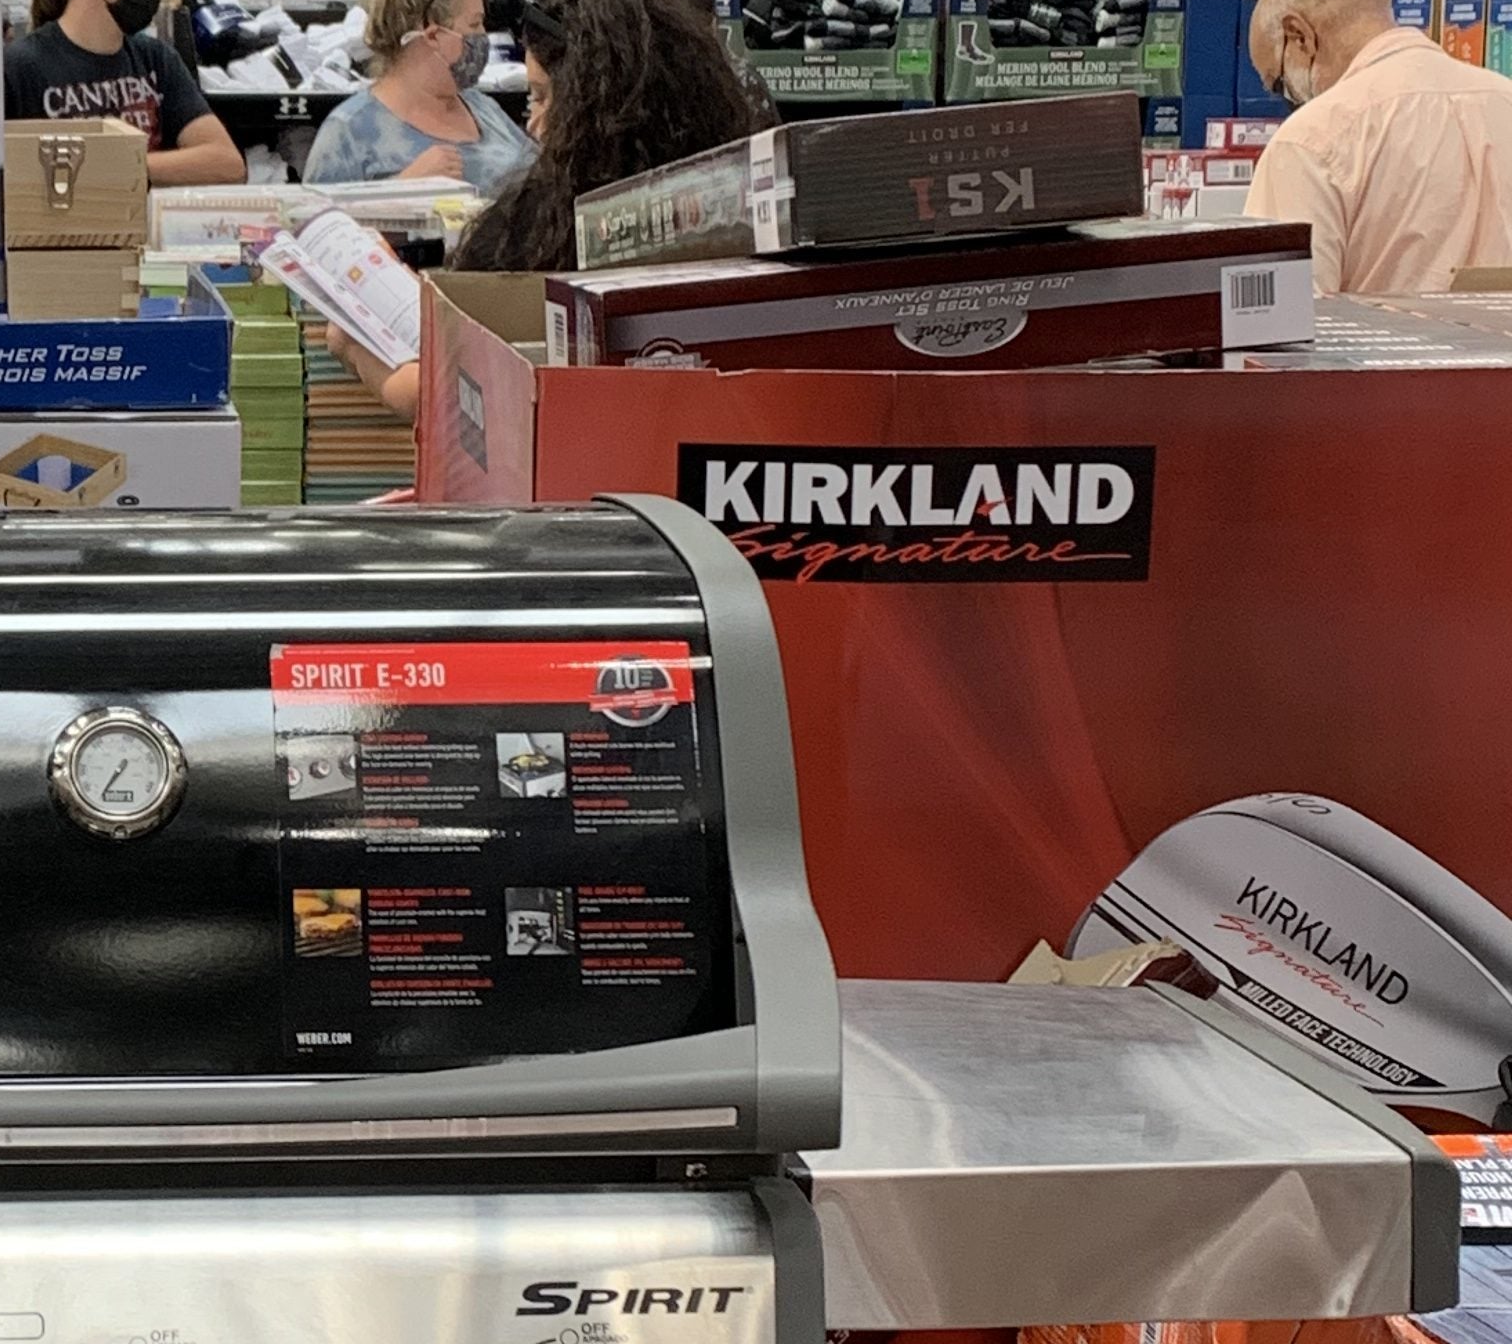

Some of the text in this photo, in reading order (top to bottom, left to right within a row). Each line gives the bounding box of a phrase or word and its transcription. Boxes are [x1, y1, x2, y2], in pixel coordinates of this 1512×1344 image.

[793, 66, 822, 77] WOOL
[825, 66, 859, 77] BLEND
[997, 63, 1038, 74] MERINO
[1039, 62, 1069, 73] WOOL
[1072, 62, 1106, 73] BLEND
[1025, 76, 1038, 86] DE
[1040, 75, 1070, 86] LAINE
[909, 120, 1029, 143] FER DROIT
[928, 146, 1010, 164] PUTTER
[908, 167, 1035, 221] KS1
[938, 283, 1009, 299] LANCER
[1010, 280, 1034, 292] DE
[913, 317, 1007, 347] EastPoint
[56, 344, 124, 362] TOSS
[53, 365, 148, 382] MASSIF
[705, 460, 1135, 526] KIRKLAND
[728, 524, 1132, 584] Signature
[291, 663, 446, 688] SPIRIT E-330
[1237, 876, 1409, 1005] KIRKLAND
[1213, 913, 1384, 1027] Signature
[296, 1032, 352, 1045] WEBER.COM
[1238, 981, 1418, 1087] MILLED FACE TECHNOLOGY
[515, 1280, 745, 1316] SPIRIT
[150, 1331, 179, 1342] OFF
[581, 1323, 609, 1334] OFF
